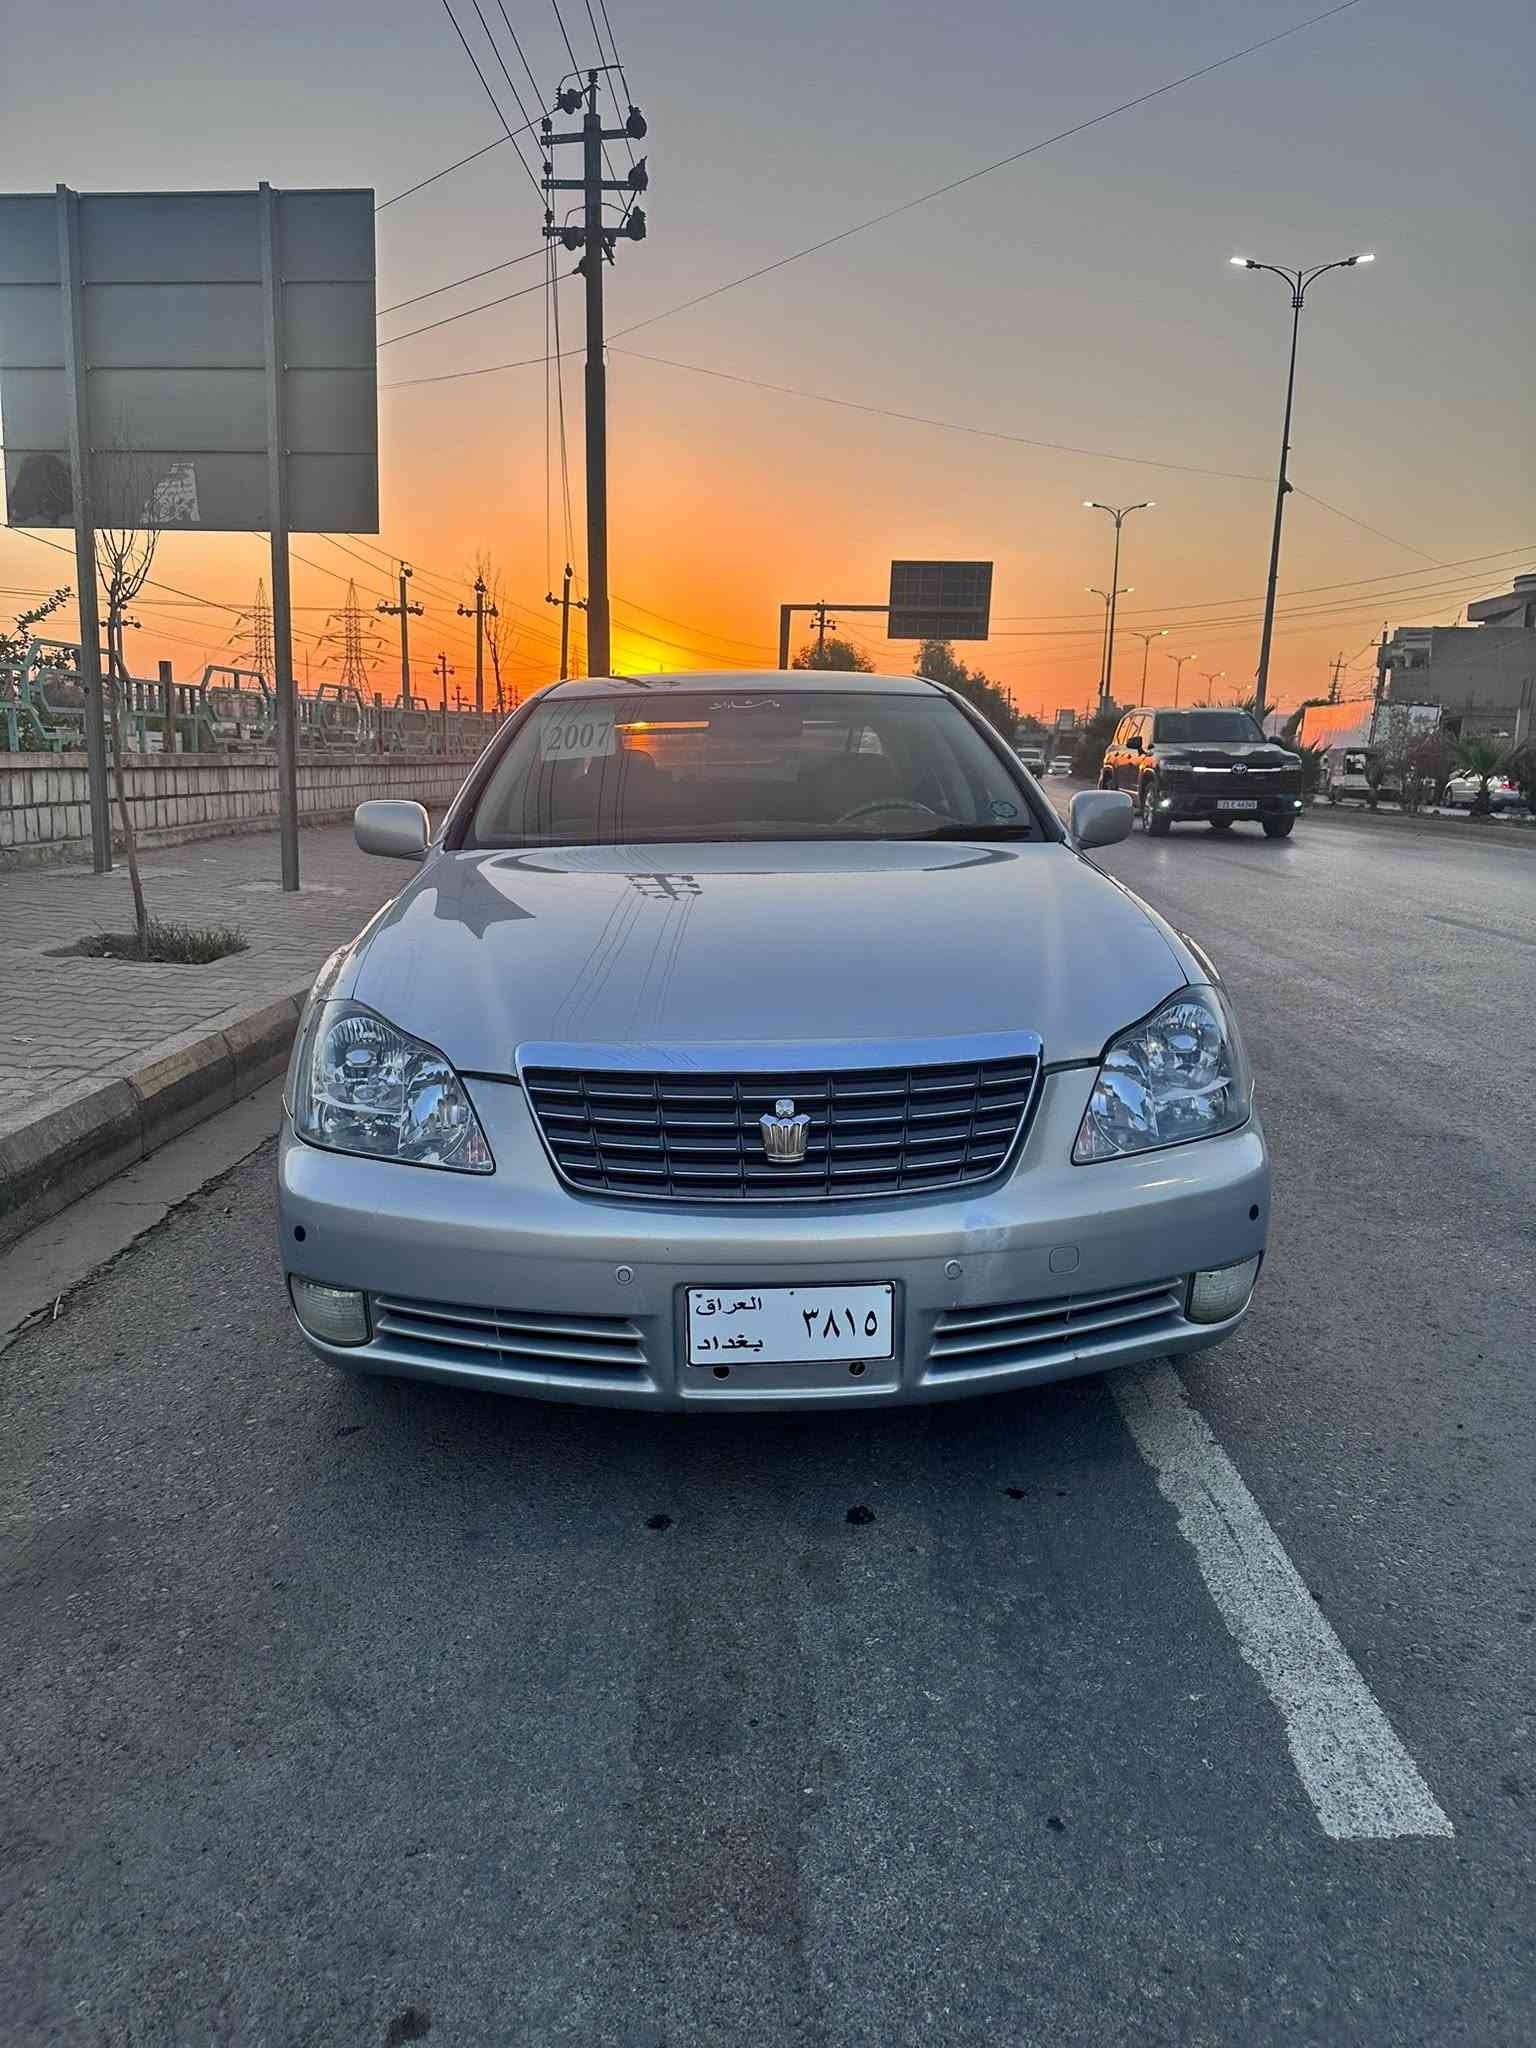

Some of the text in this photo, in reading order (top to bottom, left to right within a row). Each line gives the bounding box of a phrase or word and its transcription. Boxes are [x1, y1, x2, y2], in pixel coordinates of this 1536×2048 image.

[547, 722, 610, 751] 2007
[695, 1296, 762, 1316] العراق
[802, 1307, 878, 1339] ٣٨١٥
[697, 1333, 764, 1352] بغداد
